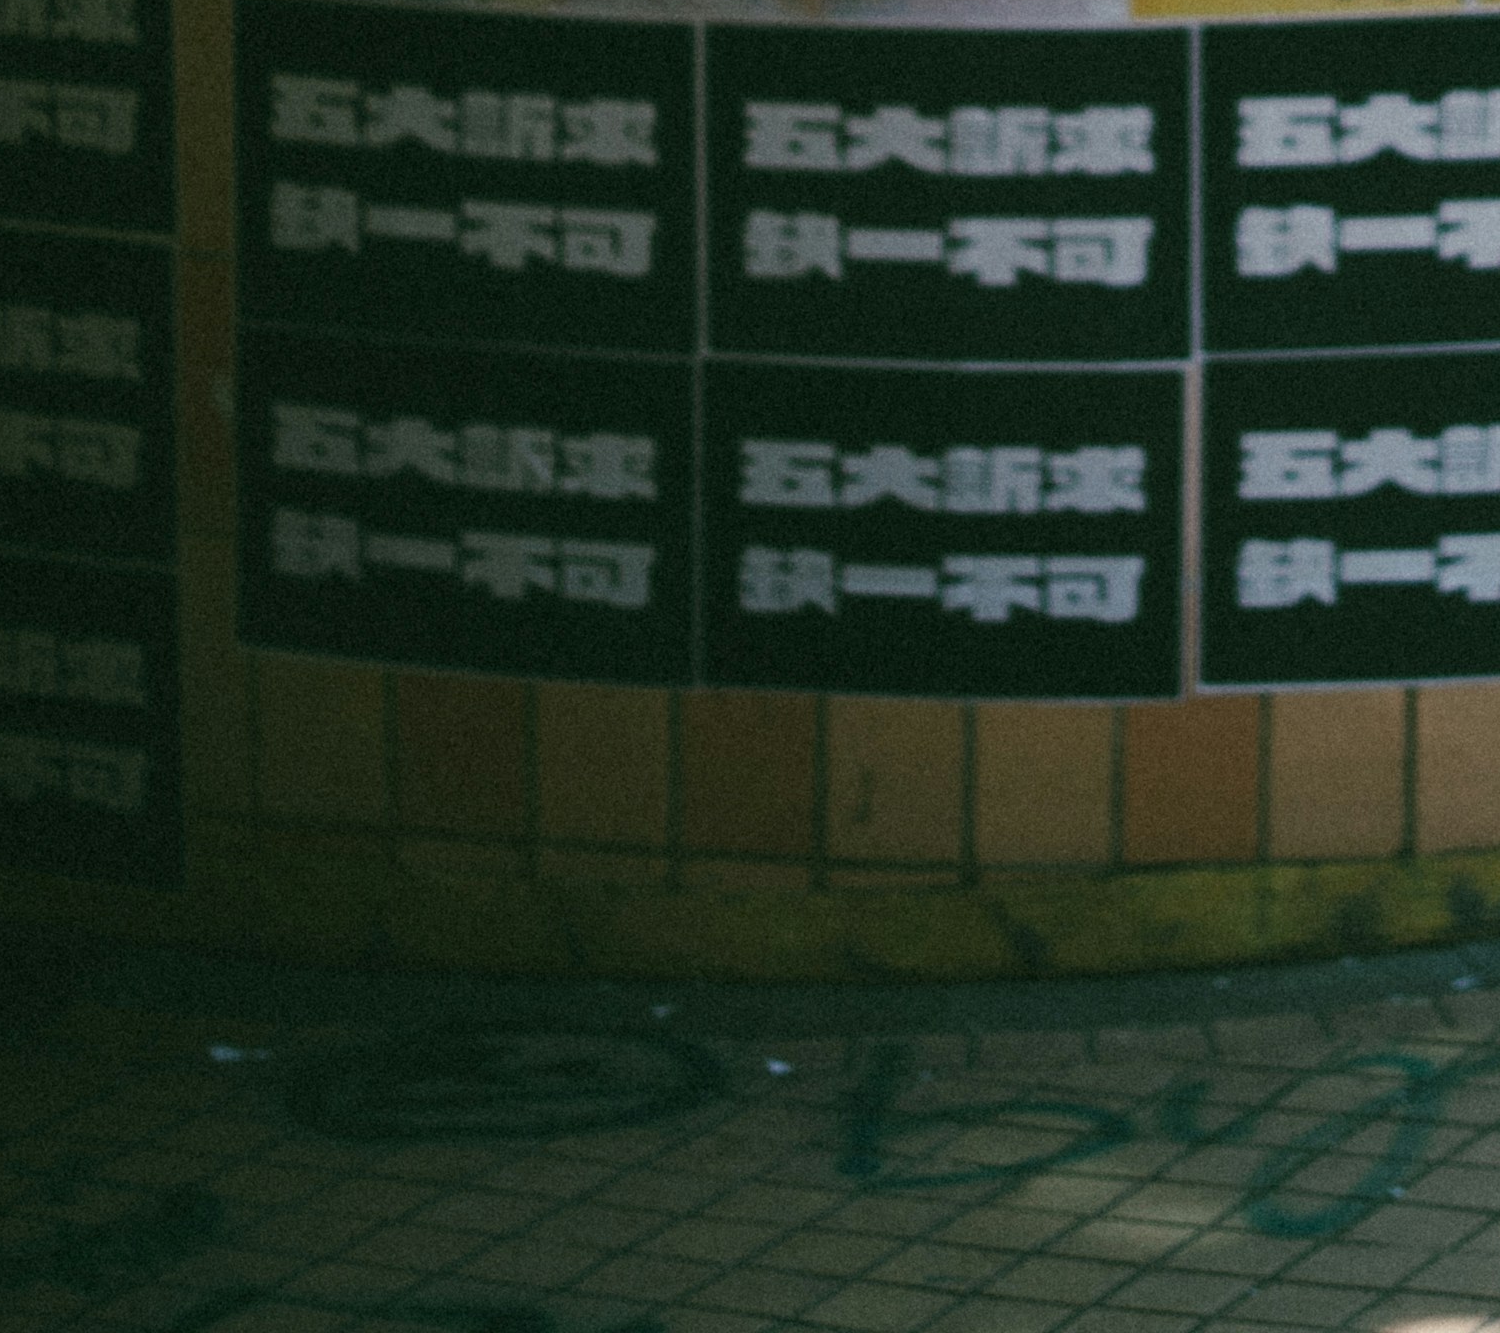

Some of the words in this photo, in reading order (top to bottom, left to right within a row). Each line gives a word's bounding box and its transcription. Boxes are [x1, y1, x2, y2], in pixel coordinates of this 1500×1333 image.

[274, 77, 658, 166] 五大訴求
[748, 105, 1155, 176] 五大訴求
[274, 185, 657, 278] 缺一不可
[747, 213, 1154, 287] 缺一不可
[276, 406, 657, 500] 五大訴求
[744, 443, 1146, 513] 五大訴求
[274, 511, 657, 609] 缺一不可
[744, 549, 1146, 623] 缺一不可
